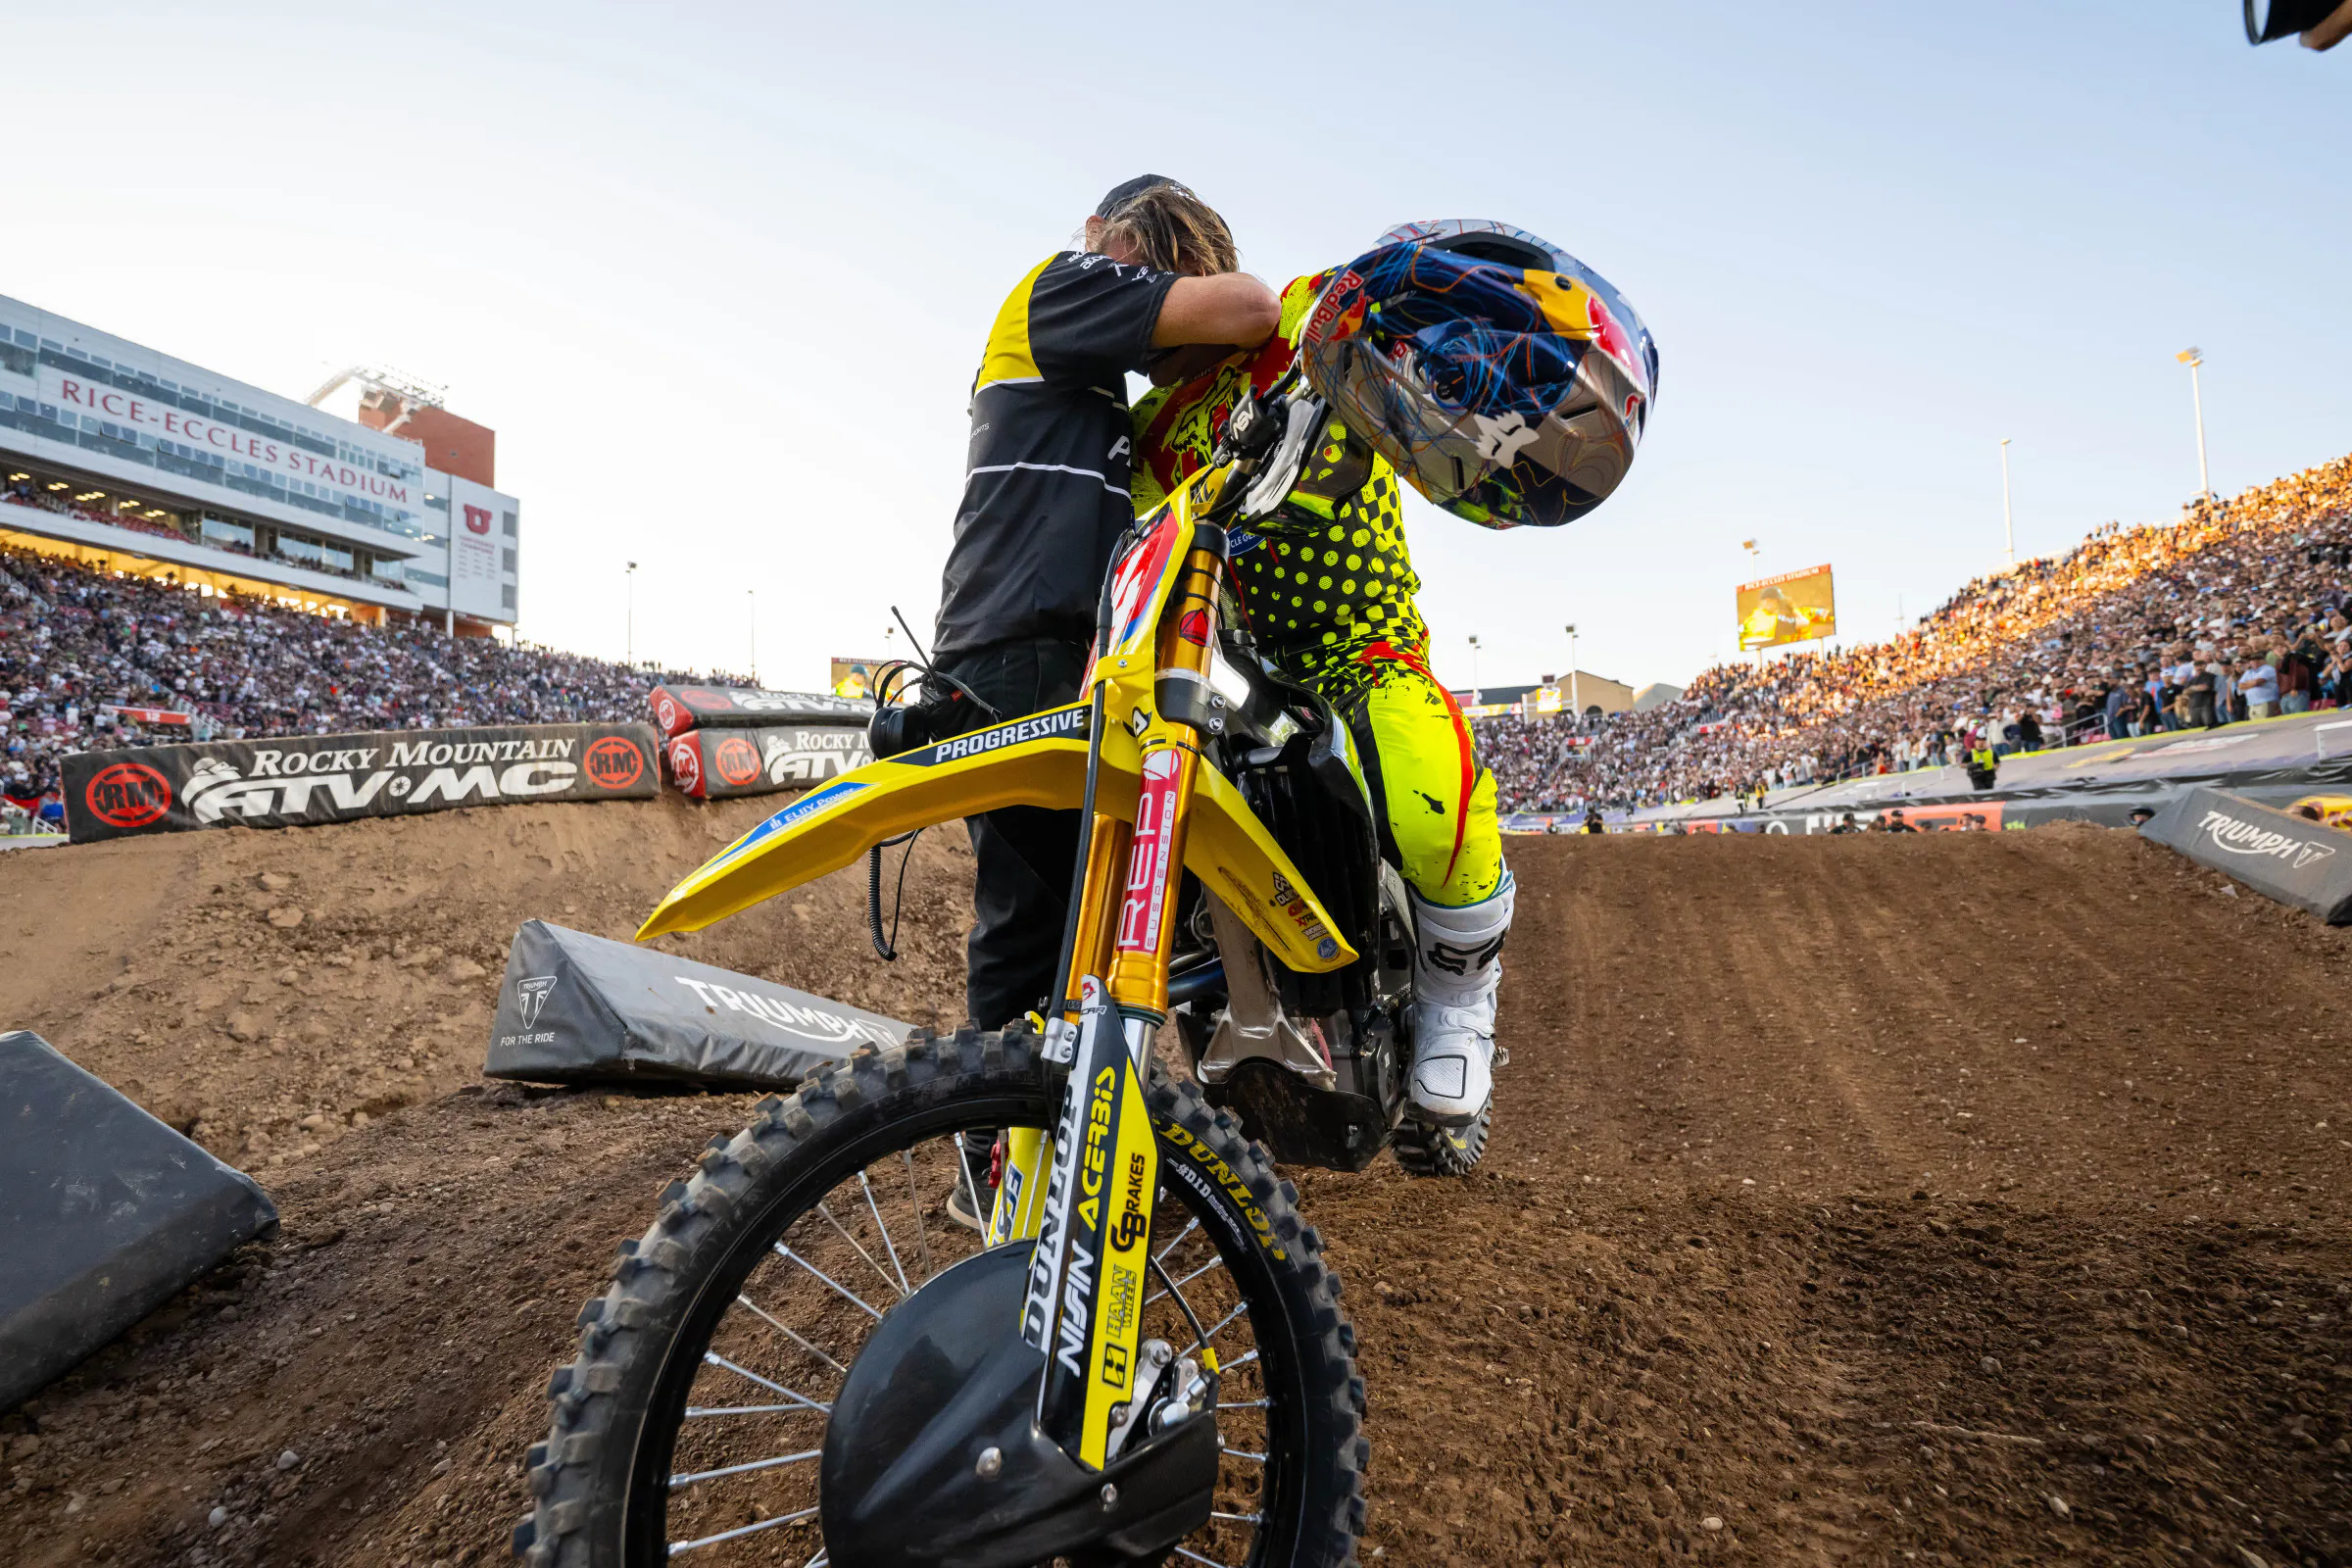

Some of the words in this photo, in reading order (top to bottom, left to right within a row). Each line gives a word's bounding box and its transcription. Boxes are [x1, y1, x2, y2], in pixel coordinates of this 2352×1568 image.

[62, 379, 278, 464] RICE-ECCLES
[289, 451, 408, 504] STADIUM
[1230, 536, 1244, 549] CLE
[248, 748, 380, 777] ROCKY
[385, 738, 576, 767] MOUNTAIN
[795, 731, 857, 751] ROCKY
[935, 709, 1085, 763] PROGRESSIVE
[817, 788, 855, 808] Power
[2198, 810, 2302, 859] TRIUMPH
[1118, 792, 1155, 947] REP
[1147, 793, 1174, 948] SUSPENSION
[523, 980, 548, 992] TRIUMPH
[674, 976, 876, 1043] TRIUMPH
[500, 1036, 516, 1047] FOR
[518, 1034, 533, 1045] THE
[534, 1032, 556, 1044] RIDE
[1025, 1084, 1077, 1348] DUNLOP
[1158, 1122, 1287, 1260] DUNLOP
[1106, 1264, 1128, 1339] HAAN
[1122, 1269, 1138, 1329] WHEELS
